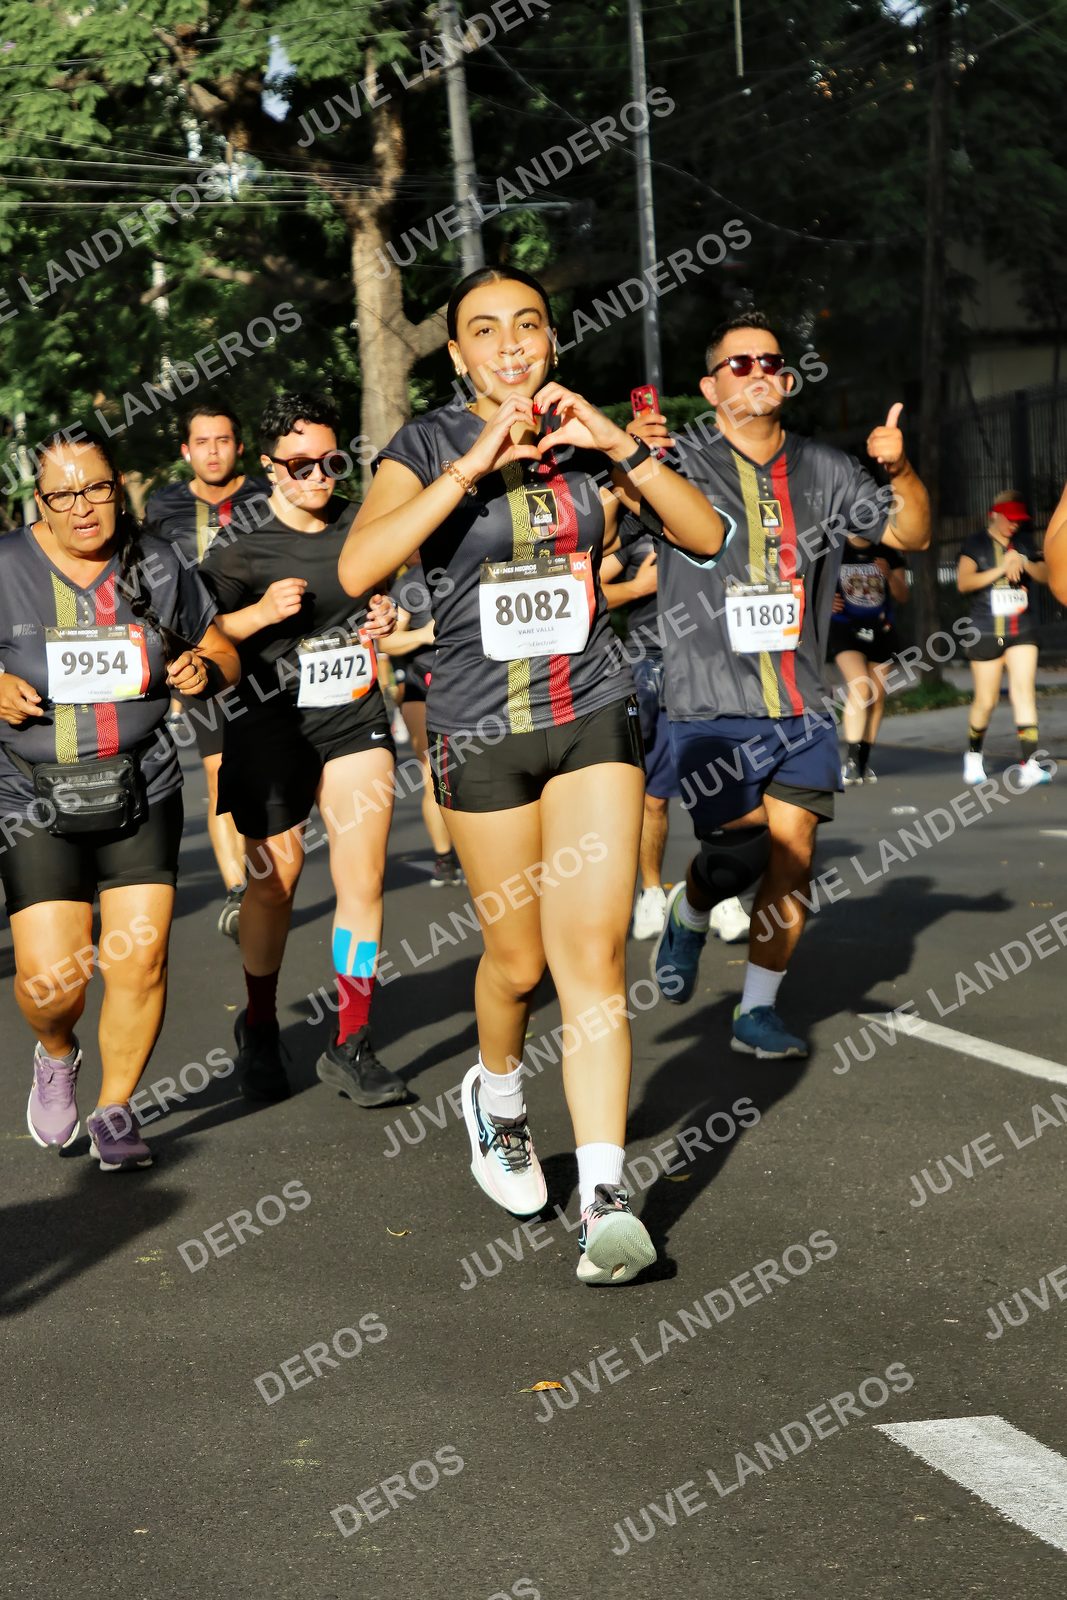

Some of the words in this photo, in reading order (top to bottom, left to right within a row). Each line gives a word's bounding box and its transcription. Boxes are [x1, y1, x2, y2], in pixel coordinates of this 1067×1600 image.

[495, 588, 571, 626] 8082
[732, 603, 796, 627] 11803
[61, 650, 128, 676] 9954
[306, 654, 367, 685] 13472
